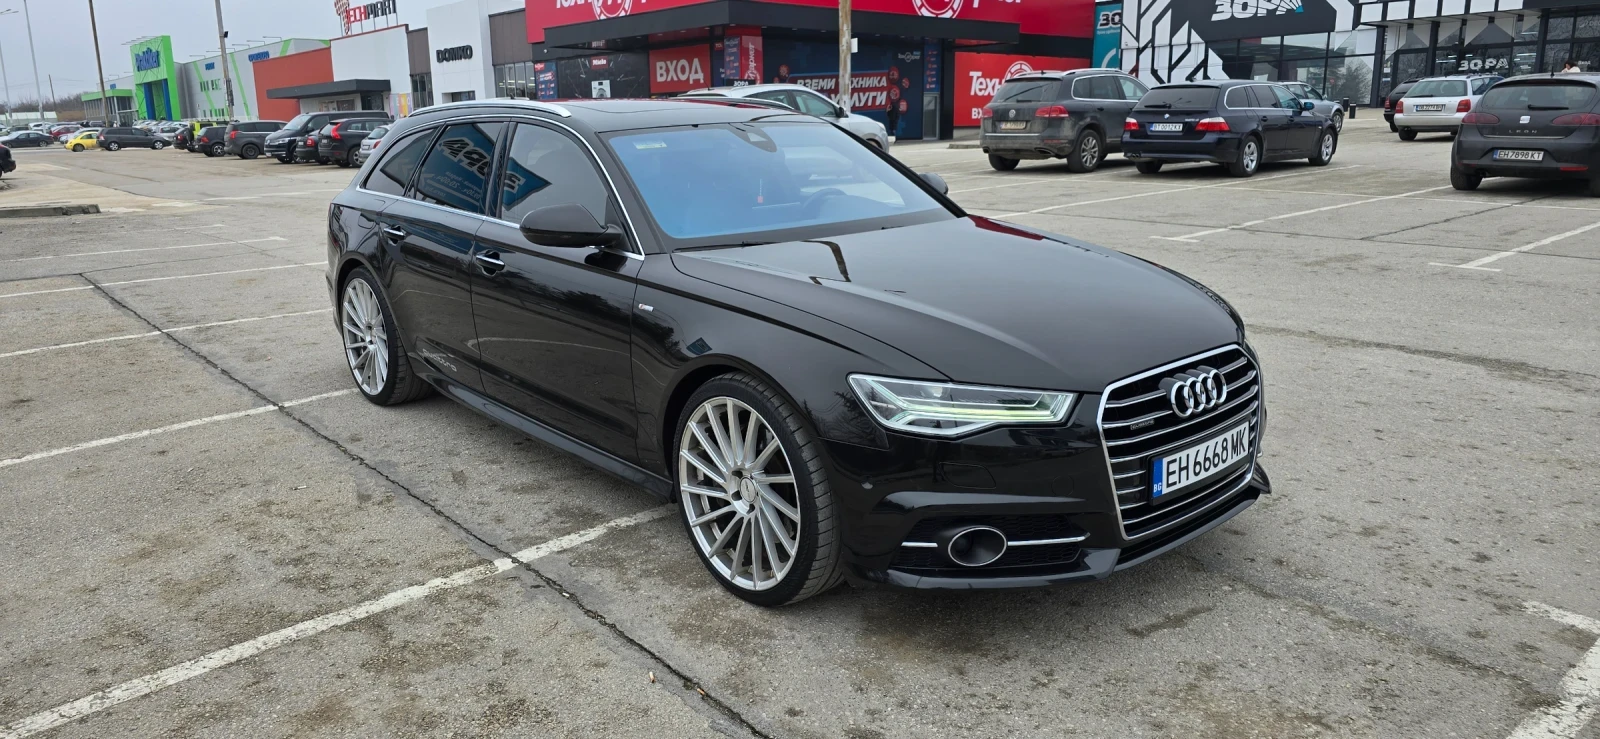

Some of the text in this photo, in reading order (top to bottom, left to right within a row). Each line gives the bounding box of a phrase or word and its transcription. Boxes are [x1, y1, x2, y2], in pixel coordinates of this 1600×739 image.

[1098, 10, 1121, 29] ЗО
[436, 45, 473, 63] DOMKO
[592, 58, 607, 66] Miele
[1458, 58, 1509, 71] ЗОРА
[656, 57, 704, 84] ВХОД
[839, 76, 887, 89] ХНИКА
[830, 91, 887, 107] УЛУГИ
[1510, 151, 1529, 159] 7898
[1166, 426, 1247, 489] EH 6668 MK
[1153, 483, 1162, 493] BG
